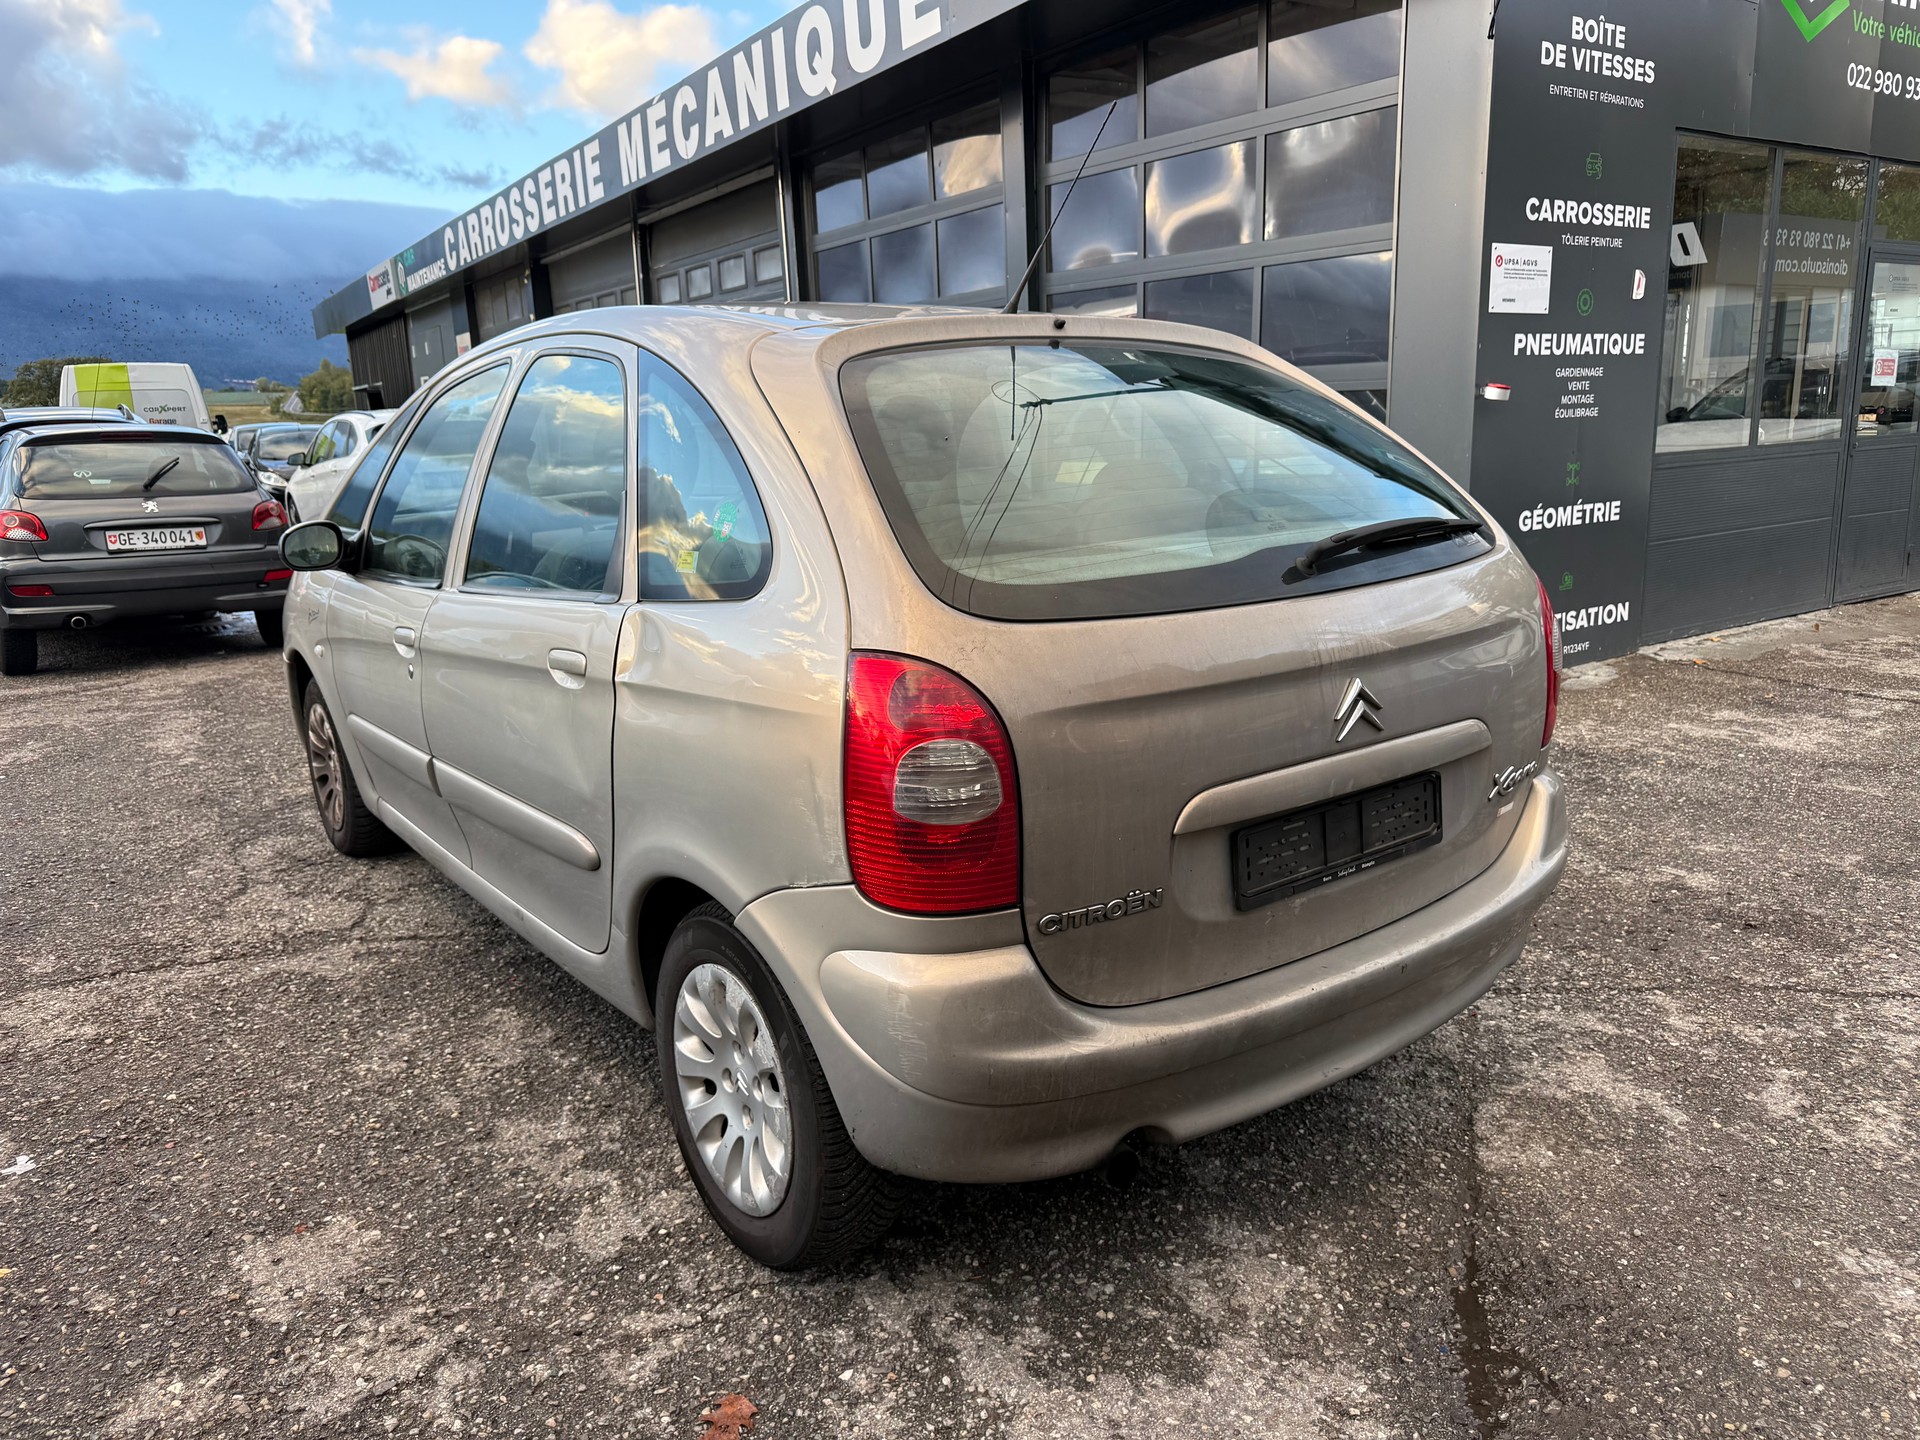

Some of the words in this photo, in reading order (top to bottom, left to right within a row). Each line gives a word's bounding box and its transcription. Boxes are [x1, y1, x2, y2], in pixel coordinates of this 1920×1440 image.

[1571, 14, 1626, 49] BOÎTE
[1853, 9, 1886, 39] Votre
[1540, 40, 1567, 69] DE
[1571, 46, 1656, 84] VITESSES
[1847, 62, 1872, 90] 022
[1873, 69, 1902, 96] 980
[1549, 84, 1589, 100] ENTRETIEN
[1590, 90, 1599, 101] ET
[1599, 90, 1645, 109] RÉPARATIONS
[443, 138, 605, 271] CARROSSERIE
[617, 0, 943, 189] MÉCANIQUE
[1525, 197, 1651, 229] CARROSSERIE
[1561, 233, 1589, 247] TÔLERIE
[1590, 236, 1623, 248] PEINTURE
[1513, 333, 1646, 356] PNEUMATIQUE
[1555, 367, 1604, 378] GARDIENNAGE
[1567, 380, 1590, 391] VENTE
[1554, 406, 1599, 419] ÉQUILIBRAGE
[1561, 394, 1595, 405] MONTAGE
[1518, 499, 1621, 532] GÉOMÉTRIE
[1563, 641, 1590, 655] R1234YF
[1038, 889, 1164, 936] CITROËN
